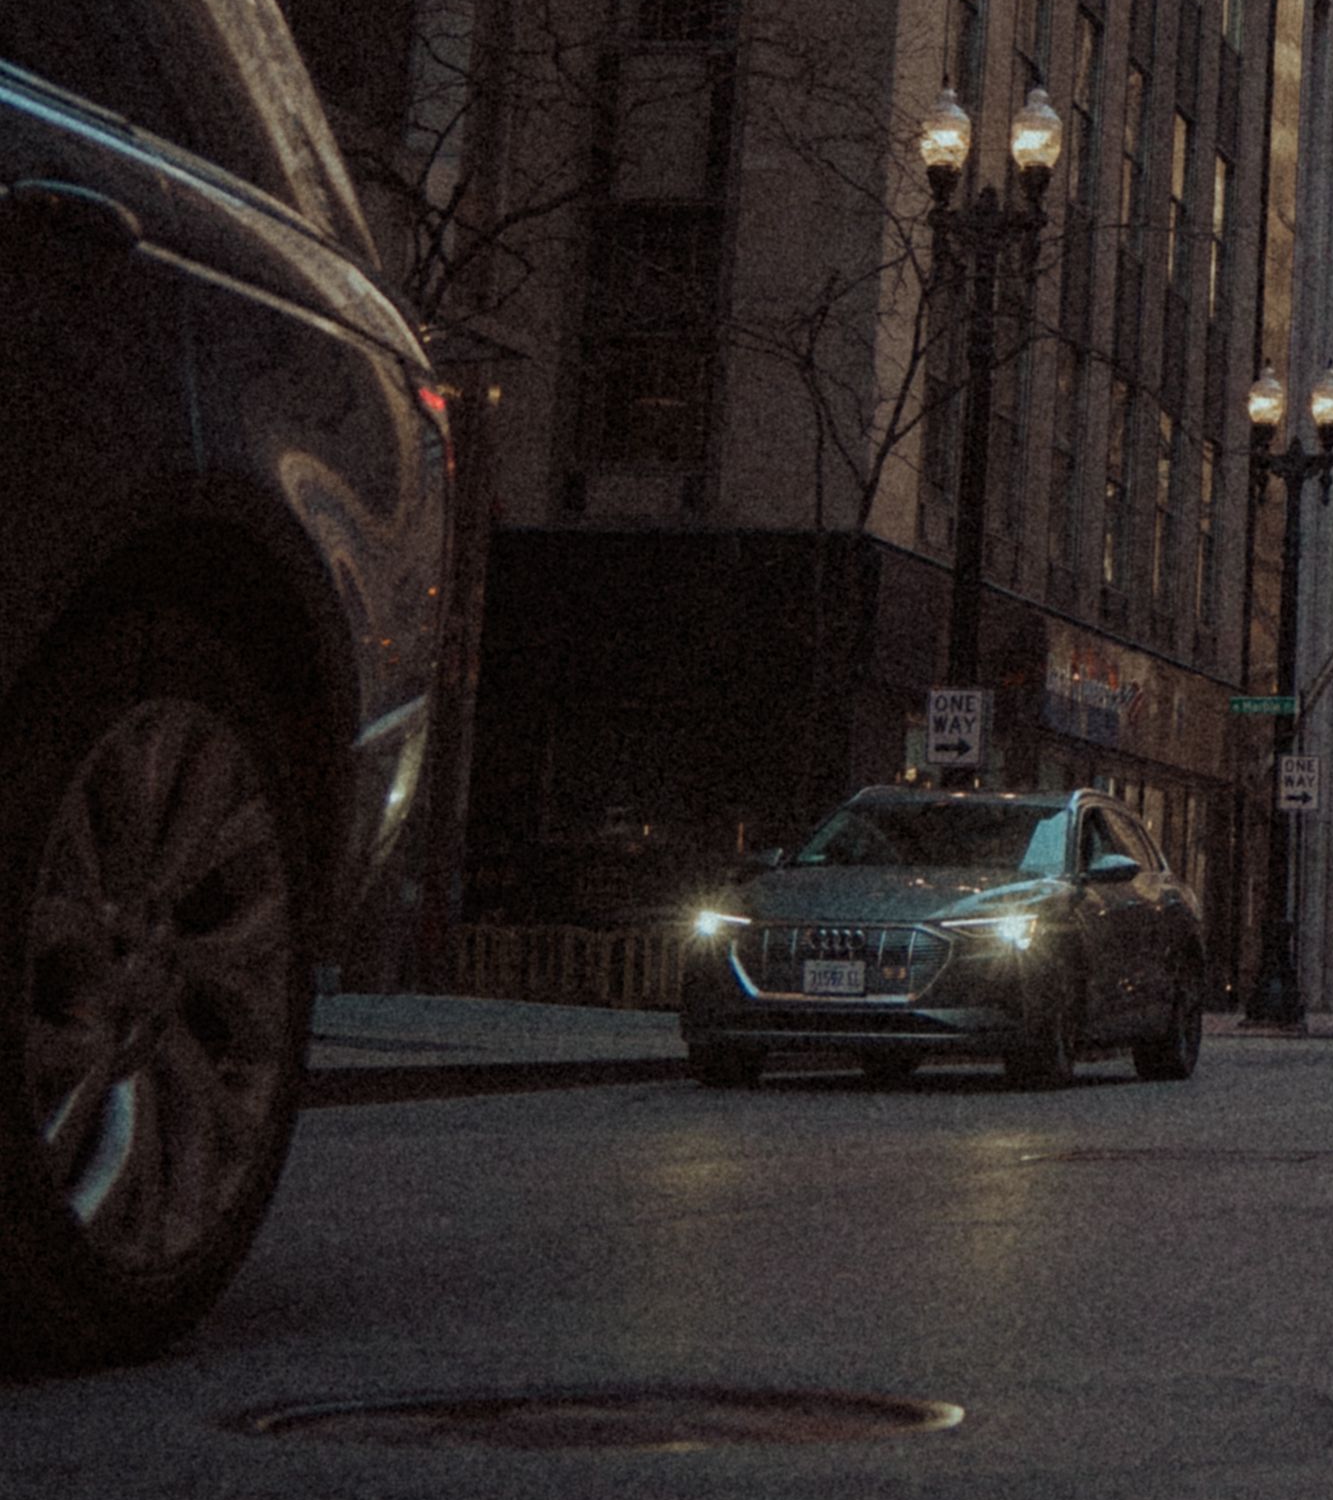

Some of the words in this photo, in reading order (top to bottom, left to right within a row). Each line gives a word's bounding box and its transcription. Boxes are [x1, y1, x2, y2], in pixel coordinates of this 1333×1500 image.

[934, 695, 976, 713] ONE
[933, 715, 976, 734] WAY
[1284, 760, 1316, 773] ONE
[1284, 776, 1316, 788] WAY
